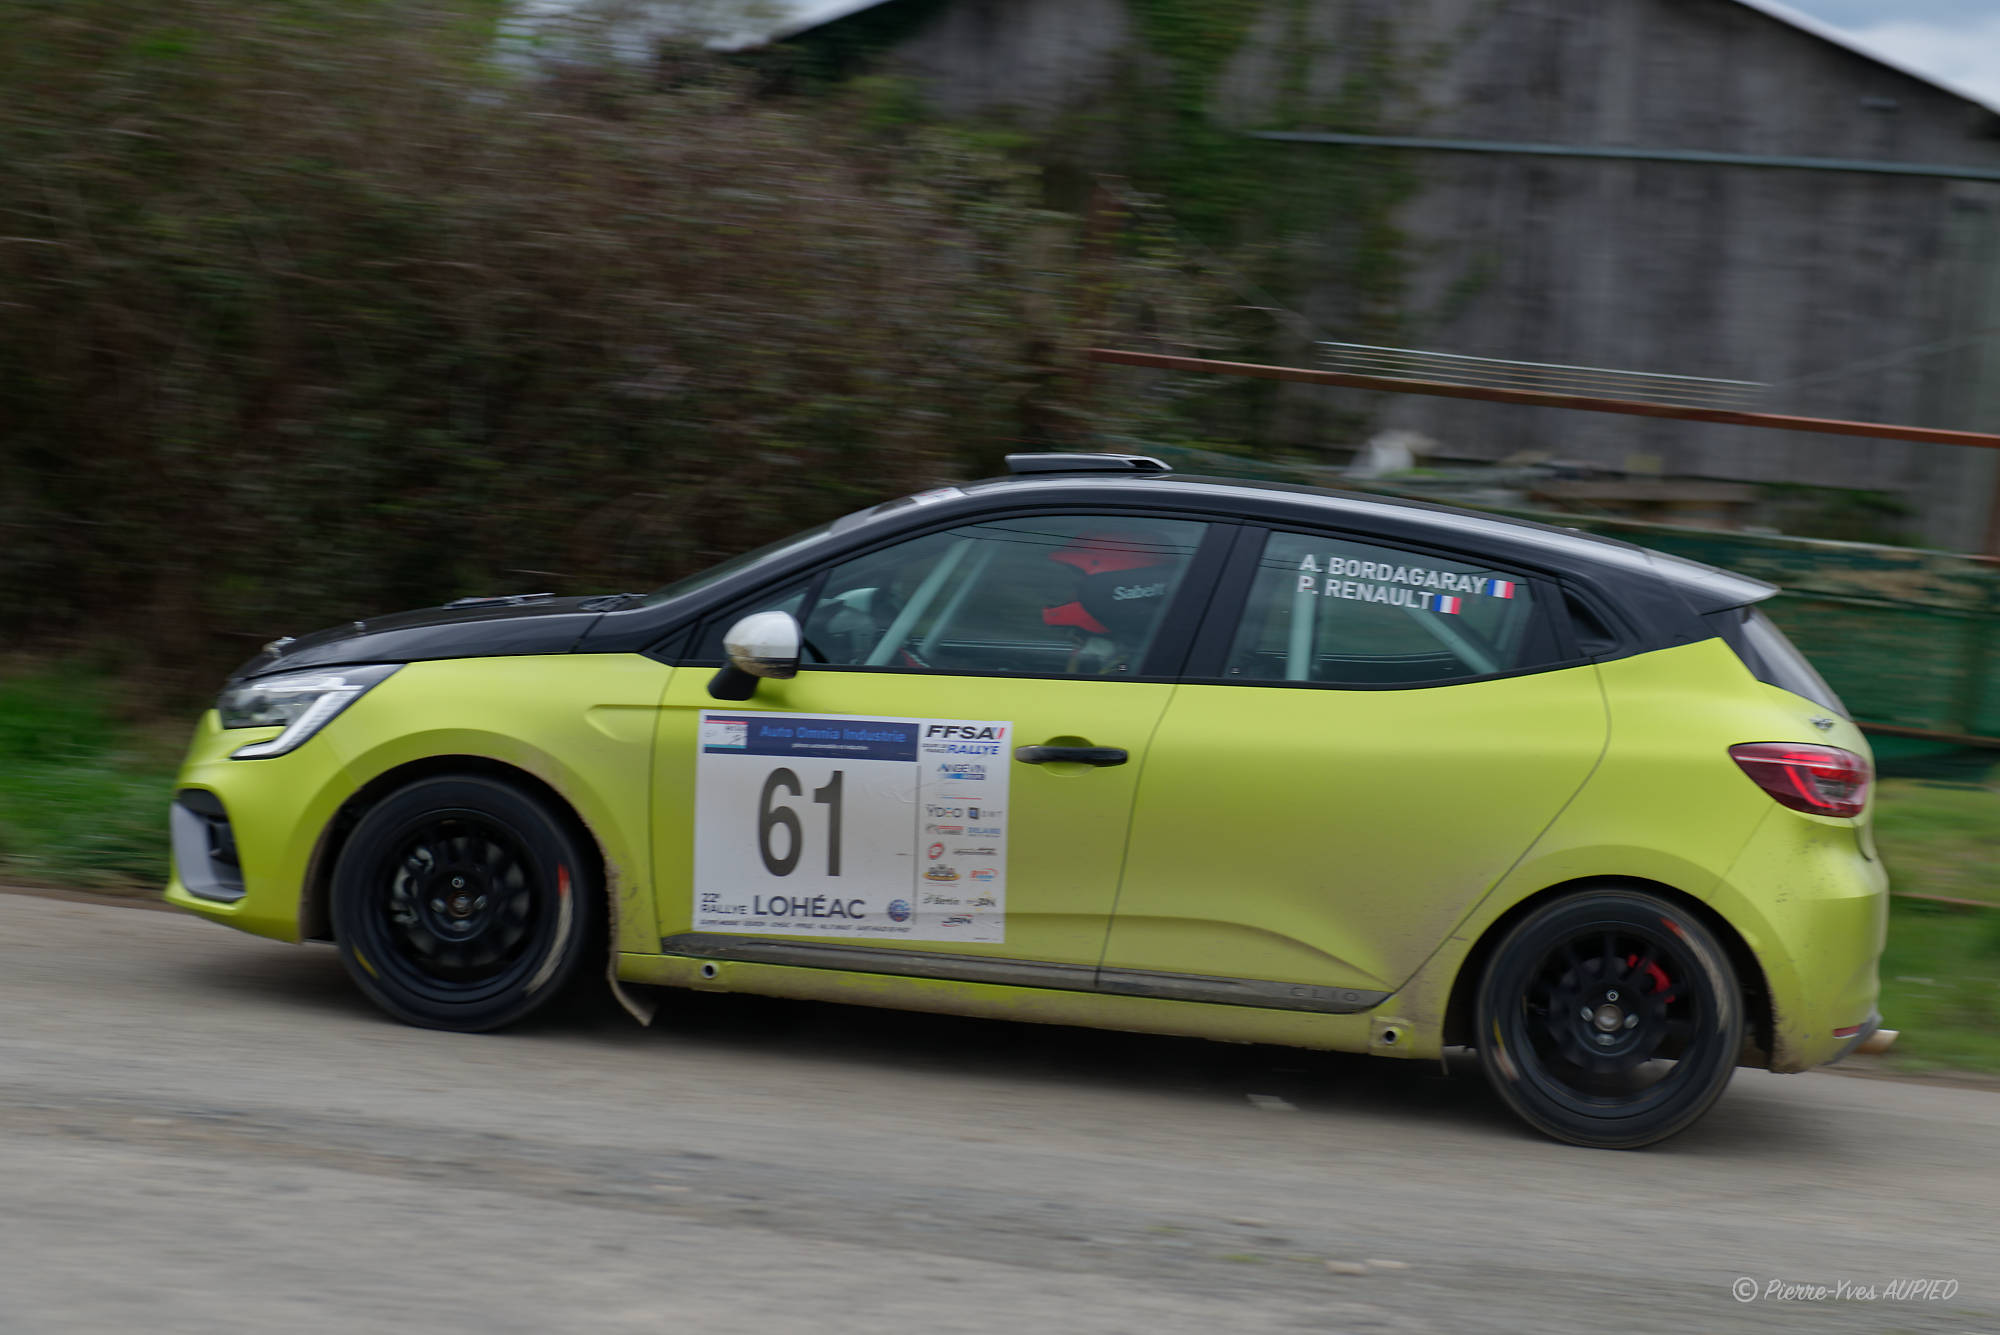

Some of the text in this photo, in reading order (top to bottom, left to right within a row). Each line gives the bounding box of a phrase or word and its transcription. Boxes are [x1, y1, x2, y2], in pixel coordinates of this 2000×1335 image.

[1299, 554, 1488, 594] A. BORDAGARAY
[1297, 575, 1434, 610] P. RENAULT
[760, 725, 793, 738] Auto
[843, 730, 906, 743] Industrie
[926, 725, 994, 740] FFSA
[948, 744, 1000, 756] RALLYE
[759, 767, 844, 877] 61
[701, 904, 747, 915] RALLYE
[754, 894, 865, 919] LOHÉAC
[1289, 987, 1360, 1002] CLIO
